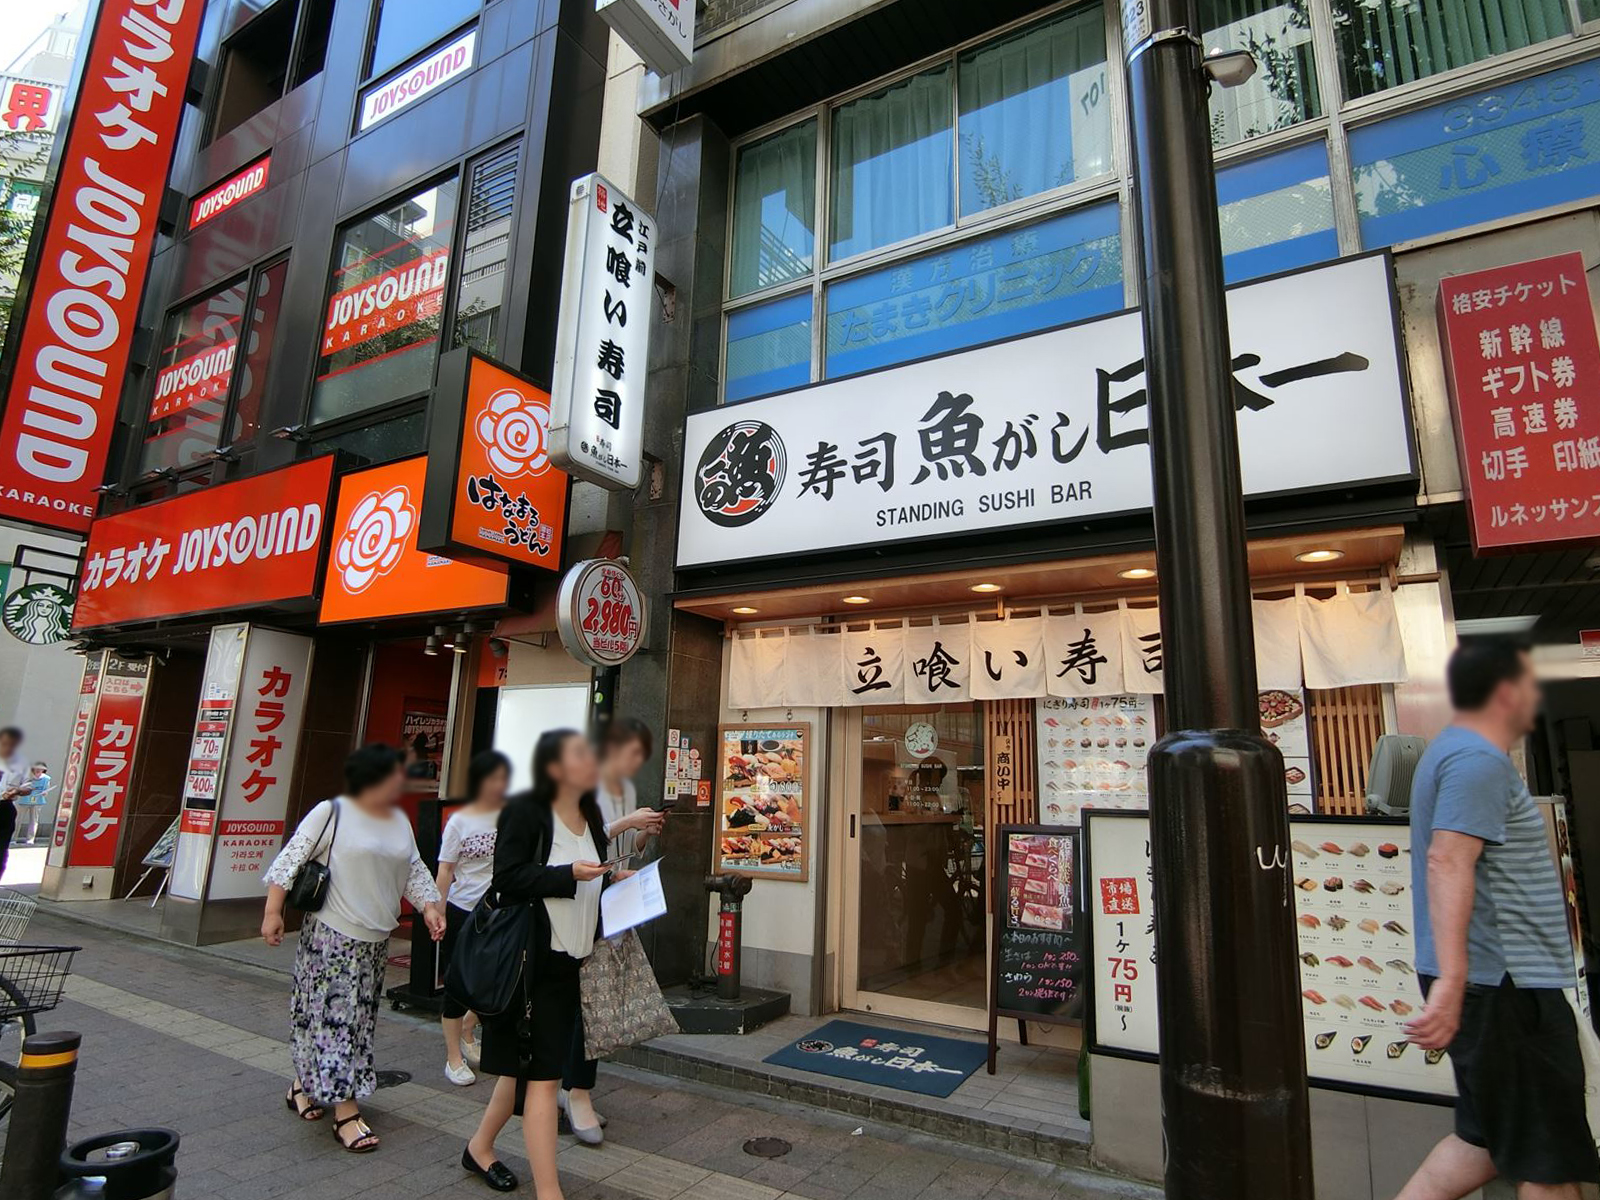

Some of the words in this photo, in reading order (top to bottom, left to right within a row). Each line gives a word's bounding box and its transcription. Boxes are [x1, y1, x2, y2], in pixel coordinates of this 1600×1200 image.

[369, 45, 467, 121] JOYSOUND
[2, 83, 52, 132] 界
[1438, 115, 1590, 190] 心療
[195, 166, 265, 223] JOYSOUND
[328, 255, 448, 331] JOYSOUND
[595, 202, 635, 430] 立喰い寿司
[840, 249, 1099, 346] たまきクリニック
[1452, 273, 1577, 315] 格安チケット
[15, 157, 147, 484] JOYSOUND
[326, 293, 443, 349] KARAOKE
[1479, 317, 1566, 361] 新幹線
[155, 345, 236, 400] JOYSOUND
[1482, 356, 1577, 398] ギフト券
[152, 376, 230, 416] KARAOK
[1490, 398, 1579, 440] 高速券
[796, 431, 897, 501] 寿司
[1481, 446, 1530, 482] 切手
[1553, 436, 1600, 473] 印紙
[0, 490, 94, 518] KARAOKE
[466, 474, 540, 528] はなまる
[876, 499, 965, 528] STANDING
[979, 488, 1036, 514] SUSHI
[1050, 480, 1093, 505] BAR
[82, 538, 171, 592] カラオケ
[173, 503, 322, 575] JOYSOUND
[502, 519, 550, 557] うどん
[1043, 698, 1090, 710] にぎり寿司
[241, 666, 292, 804] カラオケ
[53, 710, 91, 848] JOYSOUND
[80, 719, 134, 842] カラオケ
[996, 751, 1011, 791] 商い中
[223, 839, 275, 847] KARAOKE
[226, 823, 276, 833] JOYSOUND
[231, 850, 264, 859] 가라오케
[248, 862, 260, 871] OK
[1106, 881, 1133, 896] 市場
[1107, 897, 1136, 912] 直送
[825, 1046, 964, 1075] 魚がし日本一
[876, 1041, 925, 1057] 寿司
